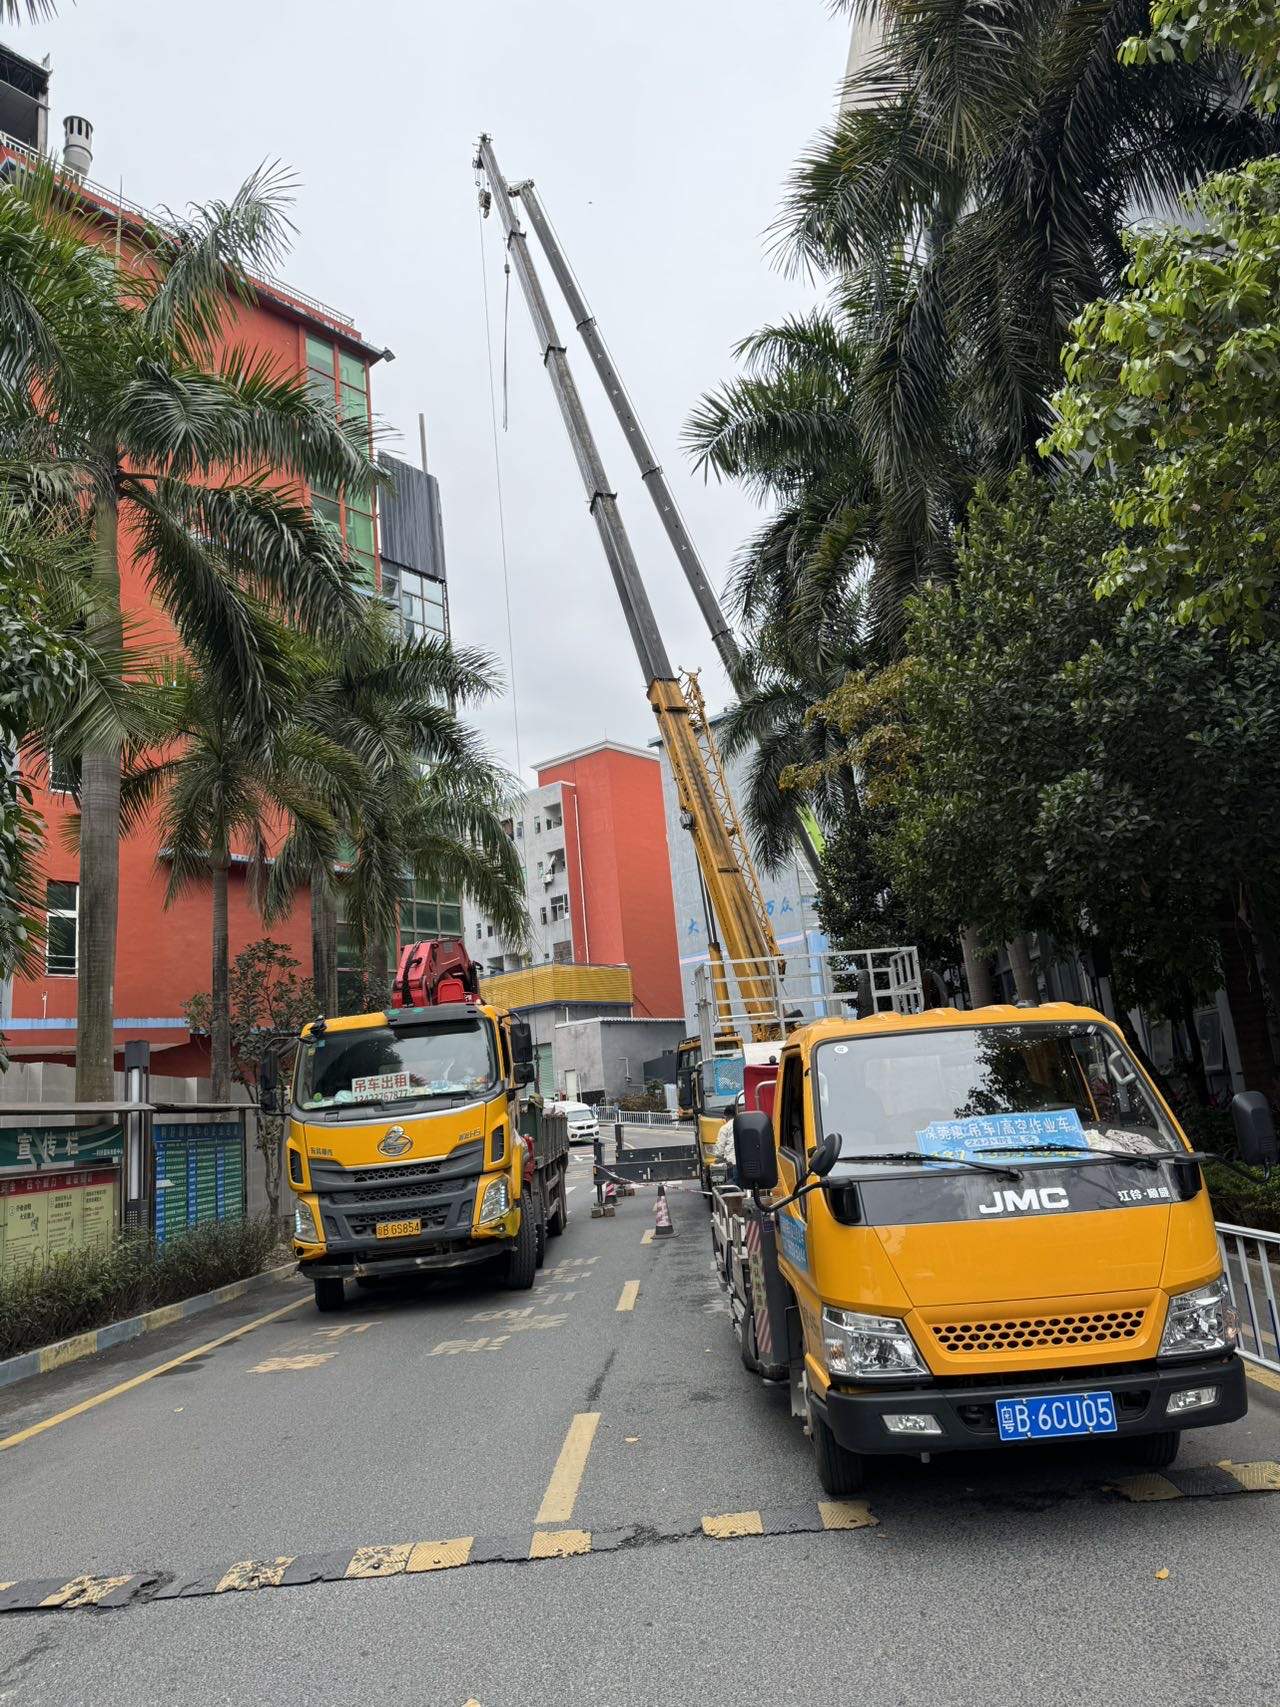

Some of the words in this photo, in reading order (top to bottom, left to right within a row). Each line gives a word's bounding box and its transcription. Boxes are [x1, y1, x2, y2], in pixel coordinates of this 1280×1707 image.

[355, 1074, 407, 1092] 吊车出租
[16, 1133, 80, 1160] 宣传栏
[979, 1187, 1070, 1214] JMC
[1001, 1398, 1113, 1433] 粤B·6CU05
